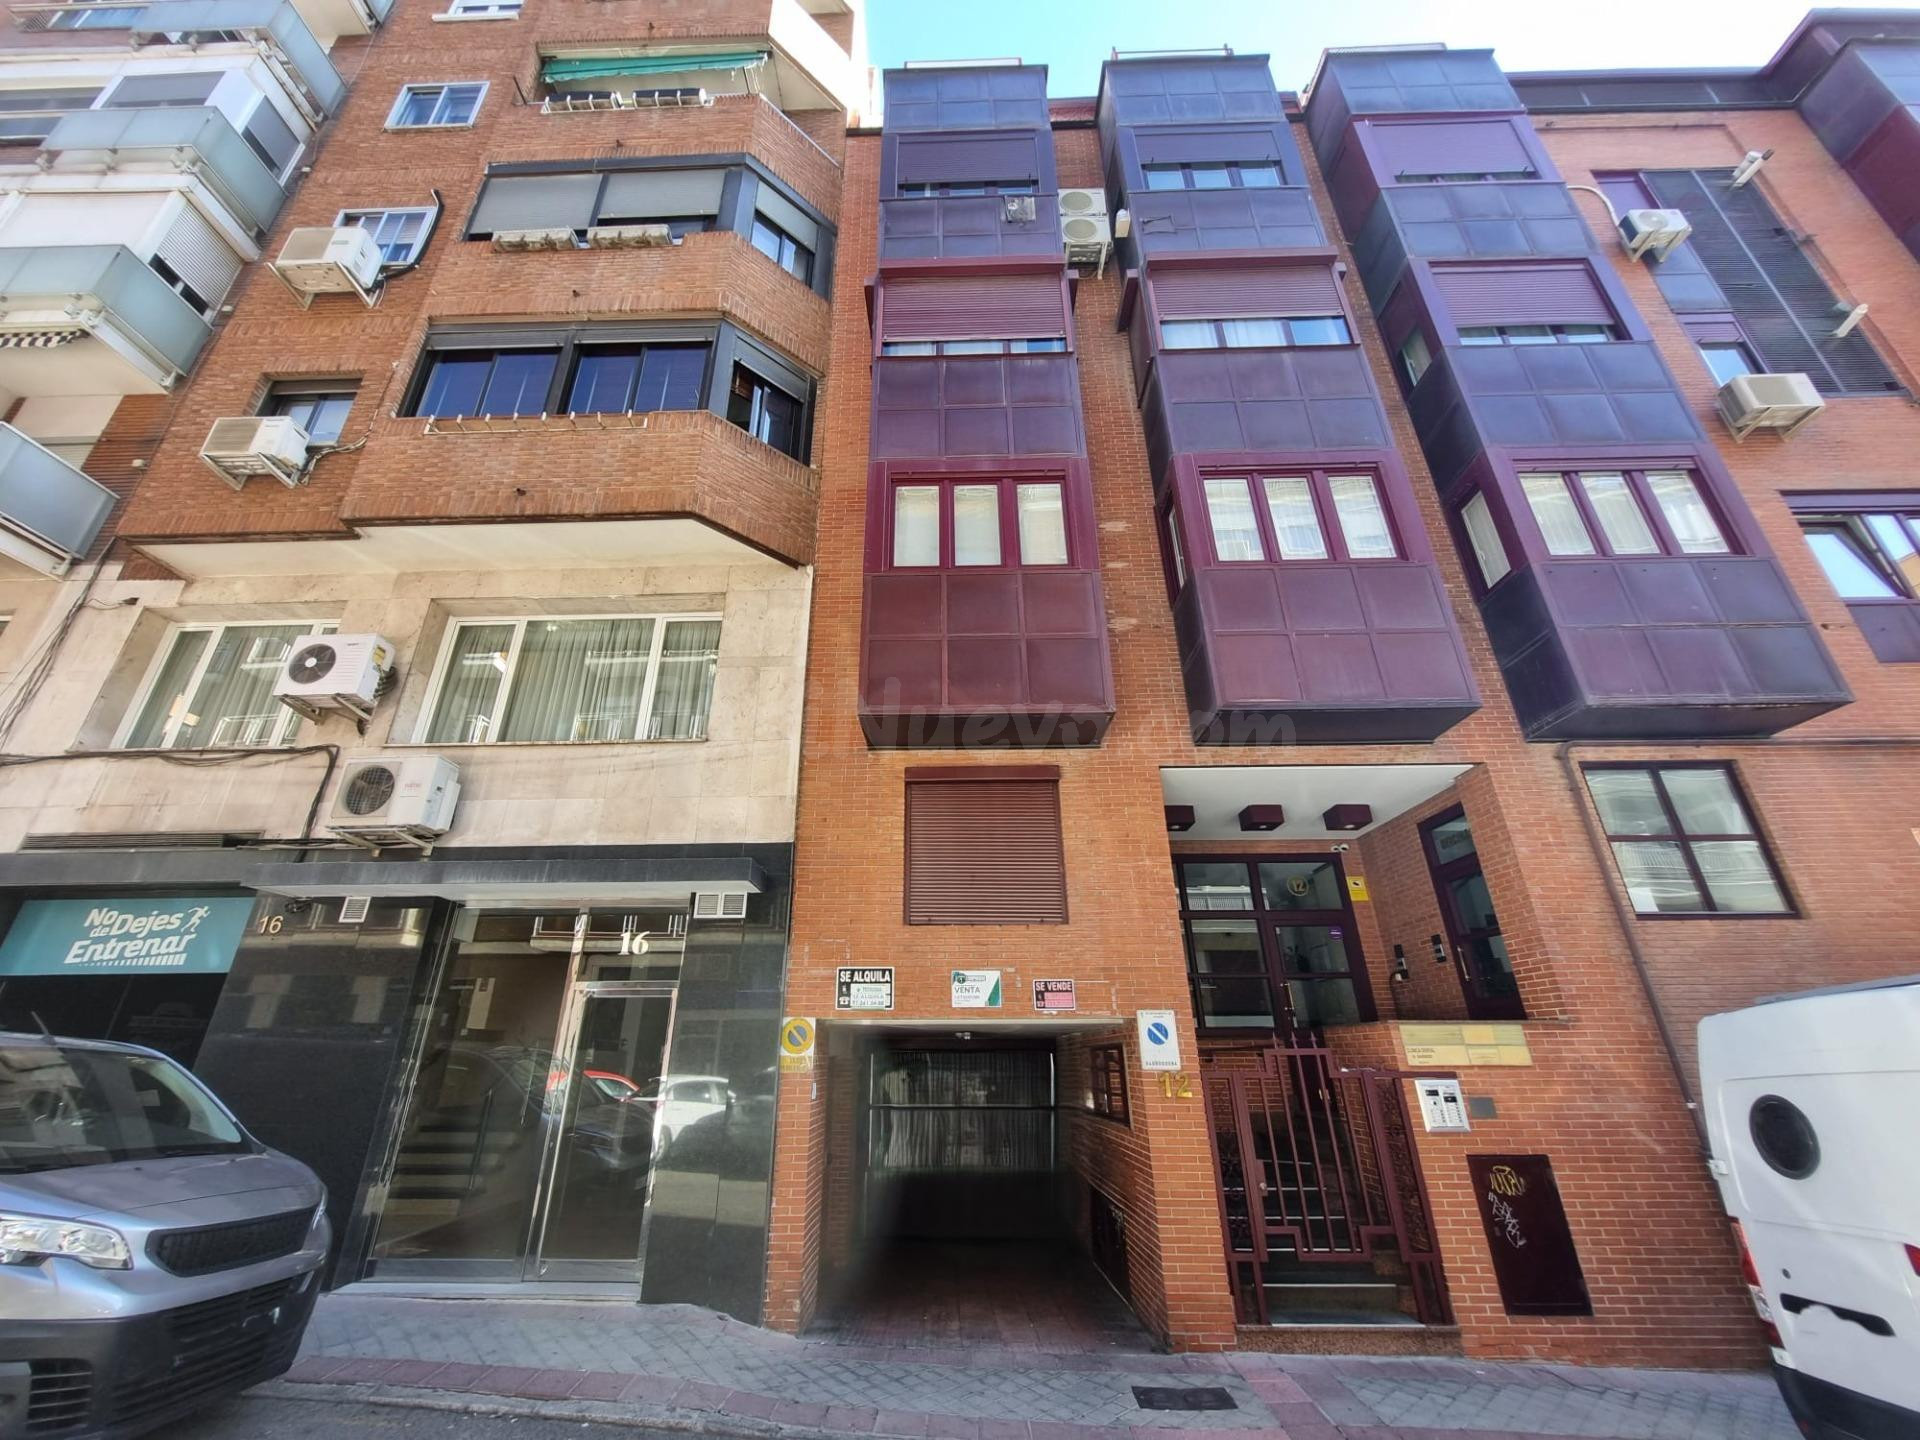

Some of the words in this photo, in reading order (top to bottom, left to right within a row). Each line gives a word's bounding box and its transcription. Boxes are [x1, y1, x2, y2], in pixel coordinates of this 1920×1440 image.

[84, 908, 119, 927] No
[112, 911, 184, 938] Dejes
[89, 924, 110, 938] de
[257, 915, 284, 935] 16
[63, 933, 197, 964] Entrenar
[618, 931, 650, 955] 16
[840, 971, 851, 982] SE
[853, 970, 890, 982] ALQUILA
[1036, 982, 1045, 991] SE
[1047, 981, 1072, 991] VENDE
[954, 986, 981, 994] VENTA
[1159, 1072, 1193, 1098] 12
